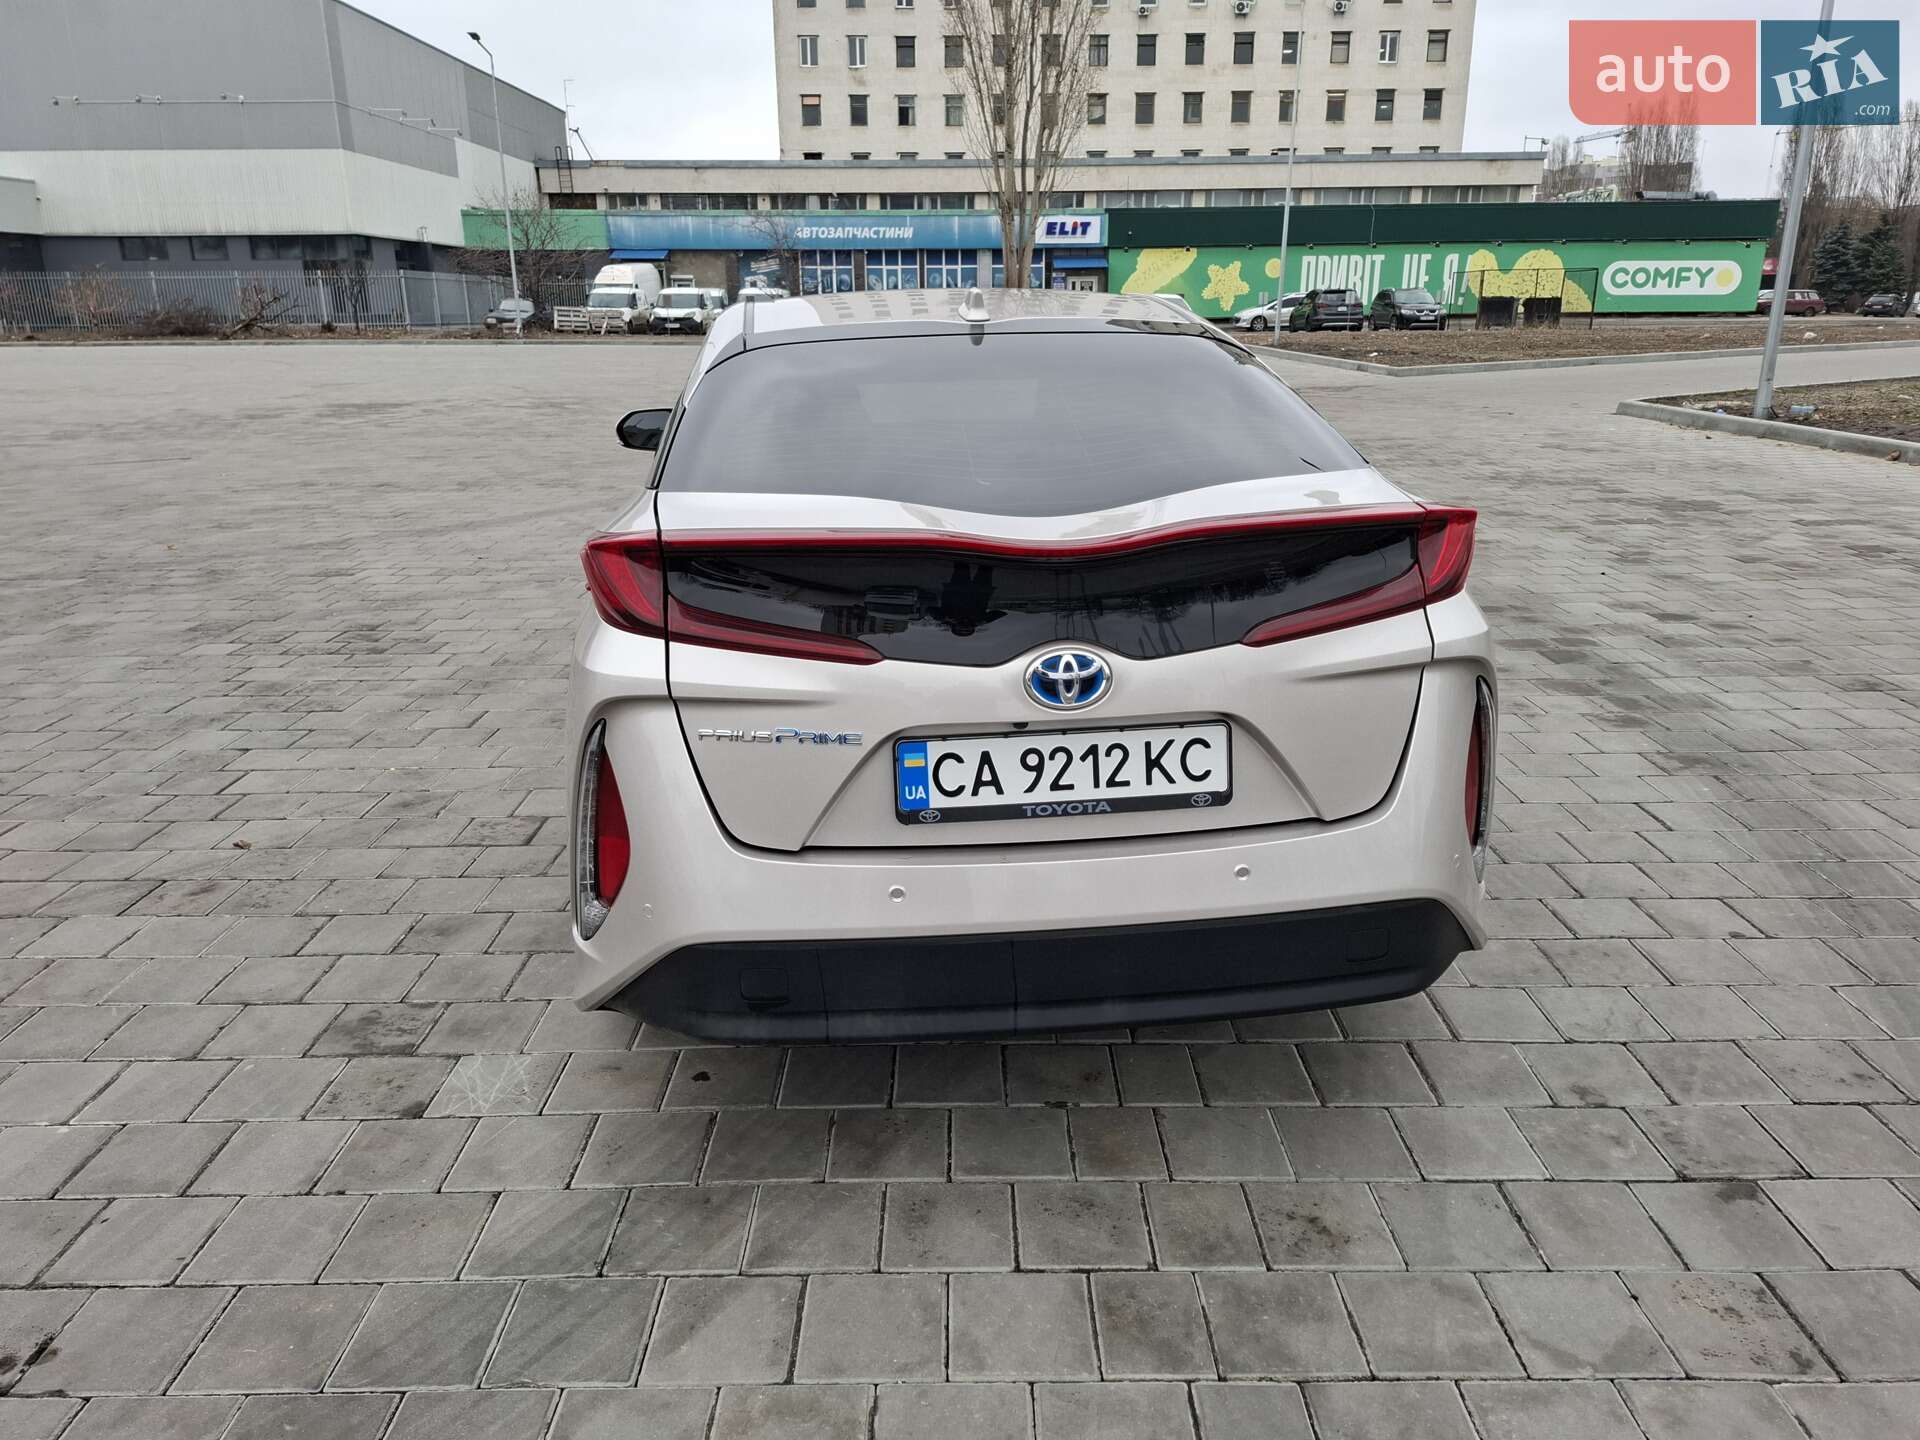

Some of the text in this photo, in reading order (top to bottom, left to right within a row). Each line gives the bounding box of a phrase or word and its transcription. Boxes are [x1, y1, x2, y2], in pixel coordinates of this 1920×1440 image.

[794, 226, 914, 239] АВТОЗАПЧАСТИНИ
[1301, 254, 1385, 306] ПРИВІТ
[1610, 266, 1715, 289] COMFY
[697, 728, 773, 743] PRIUS
[932, 738, 1213, 798] CA 9212 KC
[904, 784, 927, 800] UA
[1022, 801, 1112, 817] TOYOTA
